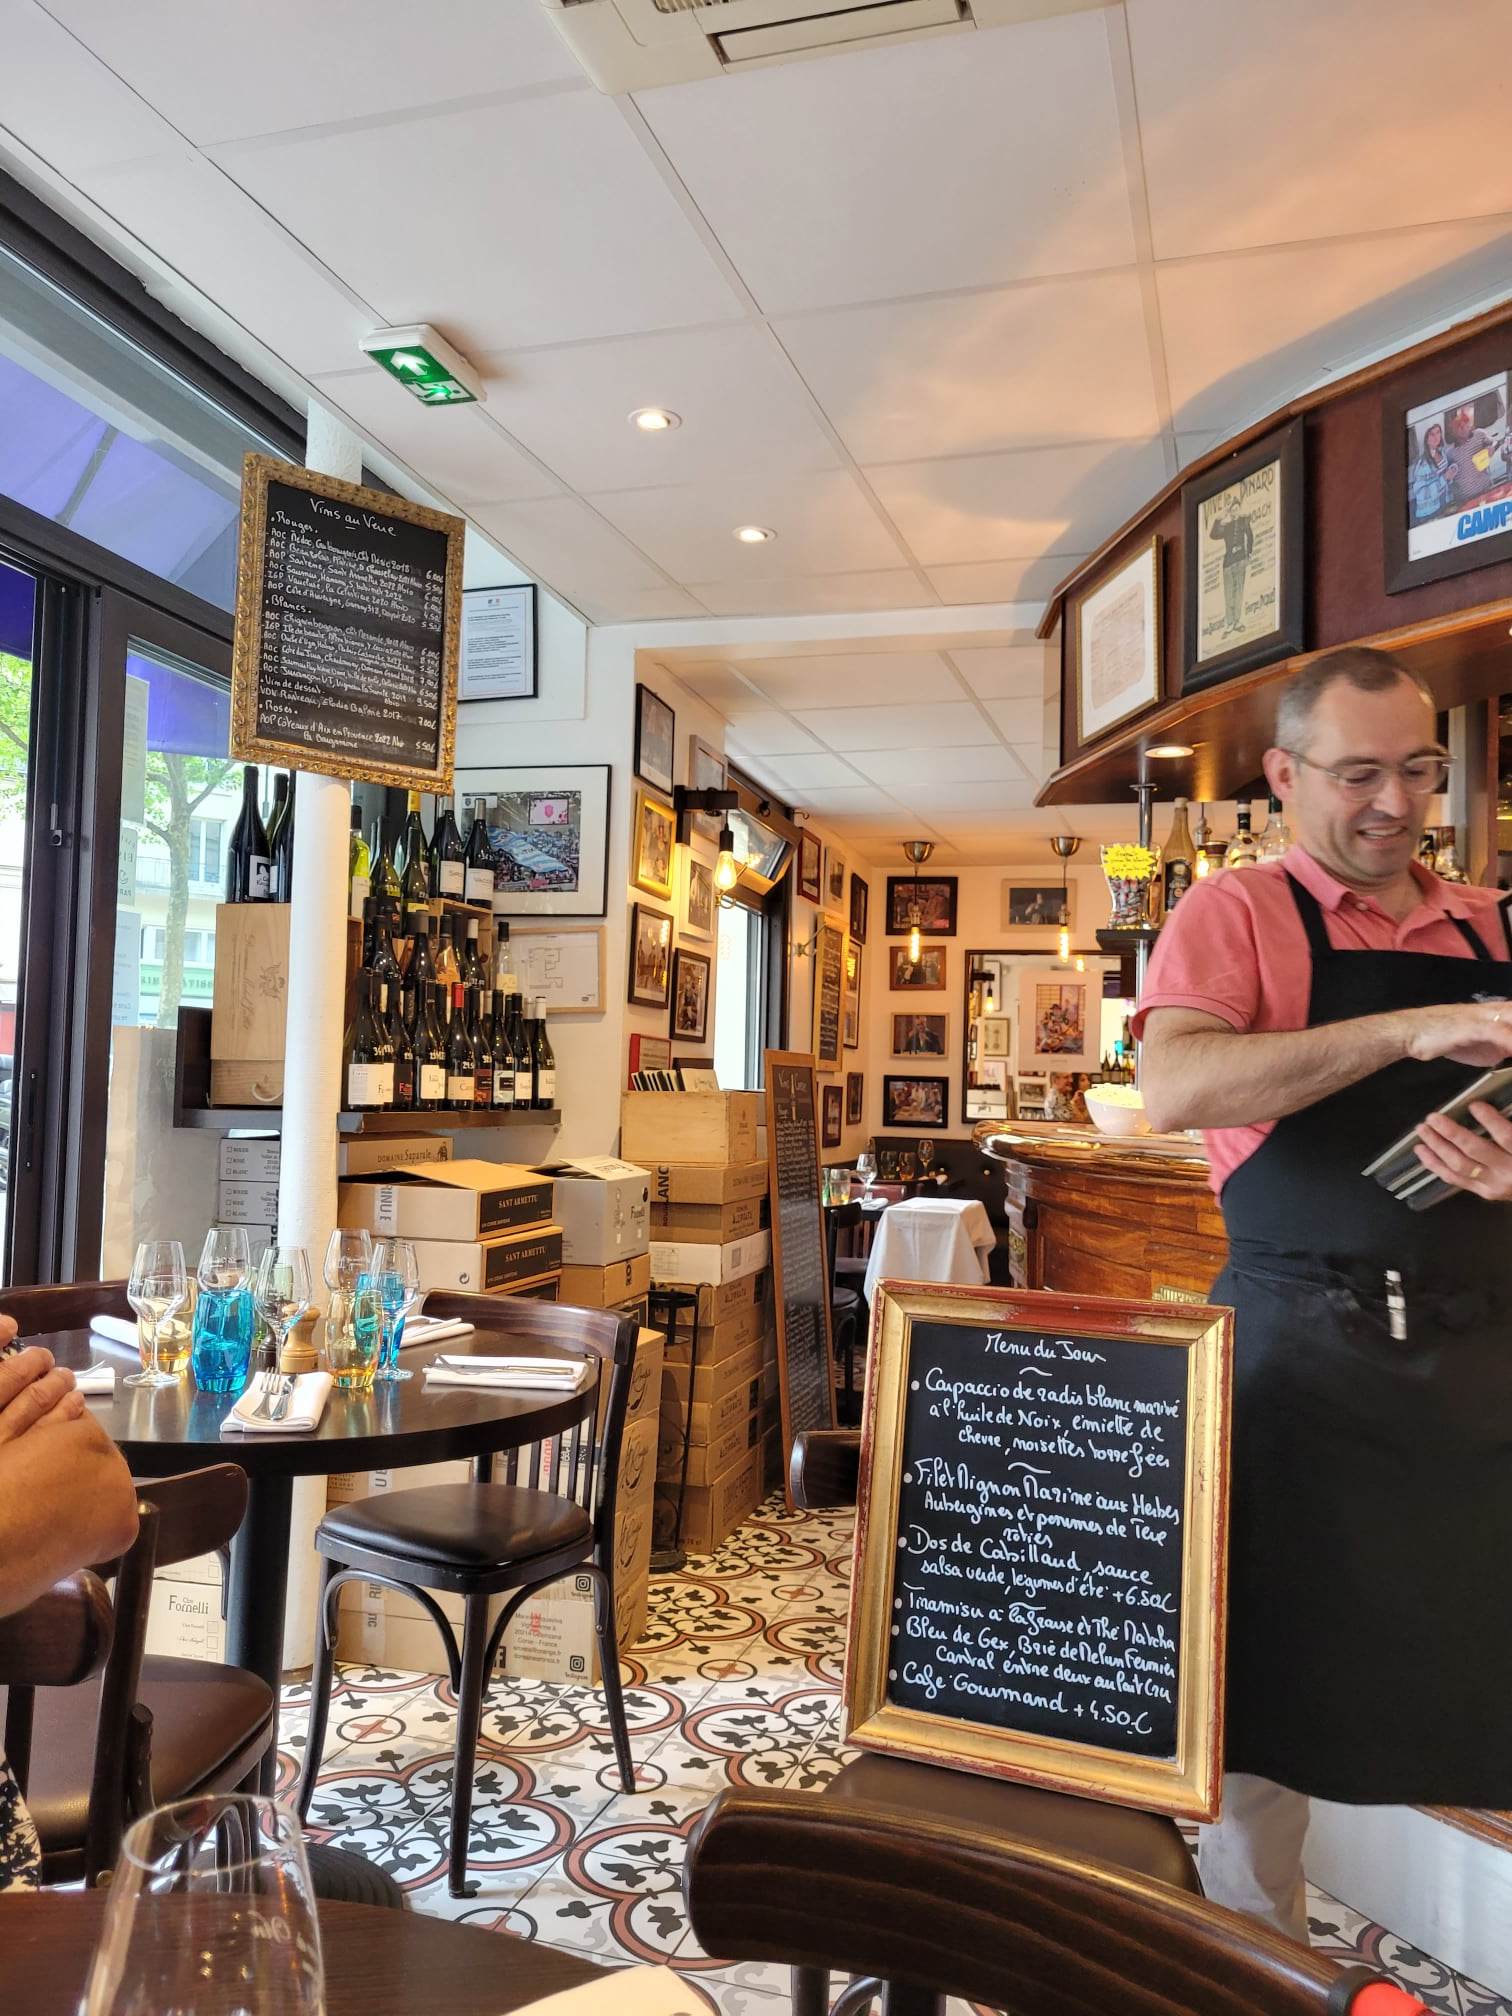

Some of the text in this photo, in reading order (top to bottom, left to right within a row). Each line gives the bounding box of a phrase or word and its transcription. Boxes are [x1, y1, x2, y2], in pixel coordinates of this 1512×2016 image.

[345, 514, 360, 525] au
[271, 527, 286, 539] AOC
[270, 537, 285, 549] AOC
[269, 548, 285, 560] AOP
[269, 560, 284, 571] AOC
[267, 579, 283, 592] AOP
[265, 610, 280, 621] AOC
[263, 641, 278, 652] AOC
[263, 652, 279, 663] AOC
[263, 662, 278, 673] AOC
[282, 678, 292, 688] de
[259, 712, 275, 724] AOP
[985, 1332, 1107, 1363] Menu du Jour
[926, 1367, 1010, 1404] Carpaccio
[1012, 1380, 1035, 1401] de
[1037, 1384, 1083, 1406] radis
[1086, 1384, 1132, 1413] blanc
[996, 1405, 1014, 1425] de
[1140, 1419, 1165, 1442] de
[914, 1457, 955, 1489] Filet
[957, 1462, 1021, 1503] Mignon
[1096, 1496, 1129, 1513] aux
[1131, 1493, 1181, 1526] Herbes
[924, 1490, 1014, 1525] Aubergines
[1017, 1503, 1036, 1522] et
[1036, 1513, 1104, 1537] pommes
[1105, 1517, 1128, 1538] de
[907, 1524, 948, 1555] Dos
[951, 1532, 973, 1554] de
[1091, 1560, 1154, 1585] sauce
[920, 1554, 963, 1578] salsa
[903, 1581, 985, 1618] Tiramisu
[1008, 1606, 1028, 1625] la
[1077, 1615, 1093, 1636] et
[1123, 1619, 1177, 1653] Matcha
[905, 1615, 949, 1639] Bleu
[952, 1624, 975, 1646] de
[1060, 1640, 1079, 1661] de
[1078, 1641, 1125, 1669] Melun
[1124, 1647, 1176, 1679] Fermier
[935, 1645, 996, 1671] Cantal
[1053, 1663, 1092, 1685] deux
[1093, 1675, 1116, 1691] au
[1116, 1670, 1143, 1695] lait
[1143, 1678, 1172, 1704] Cru
[952, 1672, 1068, 1713] Gourmand
